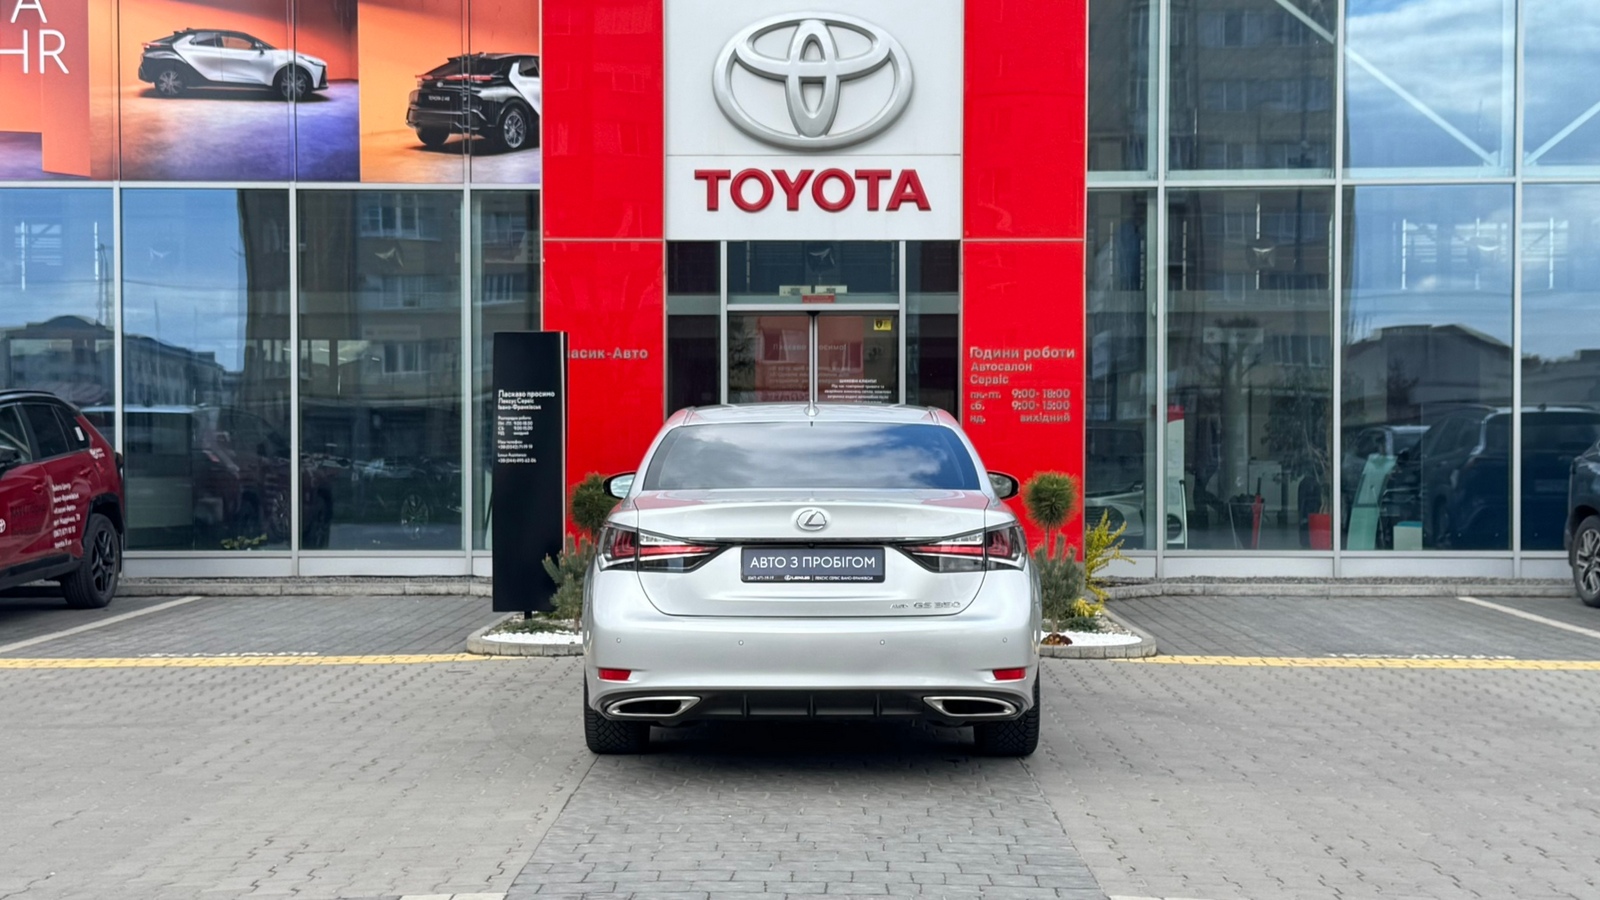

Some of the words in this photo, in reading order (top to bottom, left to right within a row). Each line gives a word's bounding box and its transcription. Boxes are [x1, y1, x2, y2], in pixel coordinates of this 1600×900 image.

[694, 168, 932, 213] TOYOTA
[567, 346, 648, 360] асик-Авто
[970, 346, 1020, 360] Години
[1024, 346, 1075, 361] роботи
[970, 362, 1032, 372] Автосалон
[970, 374, 1009, 386] Сервіс
[498, 389, 526, 398] Ласкаво
[970, 401, 985, 411] сб.
[970, 414, 986, 424] нд.
[1020, 412, 1071, 423] вихідний
[750, 556, 786, 568] АВТО
[790, 556, 798, 568] З
[802, 556, 876, 568] ПРОБІГОМ
[914, 601, 932, 609] GS
